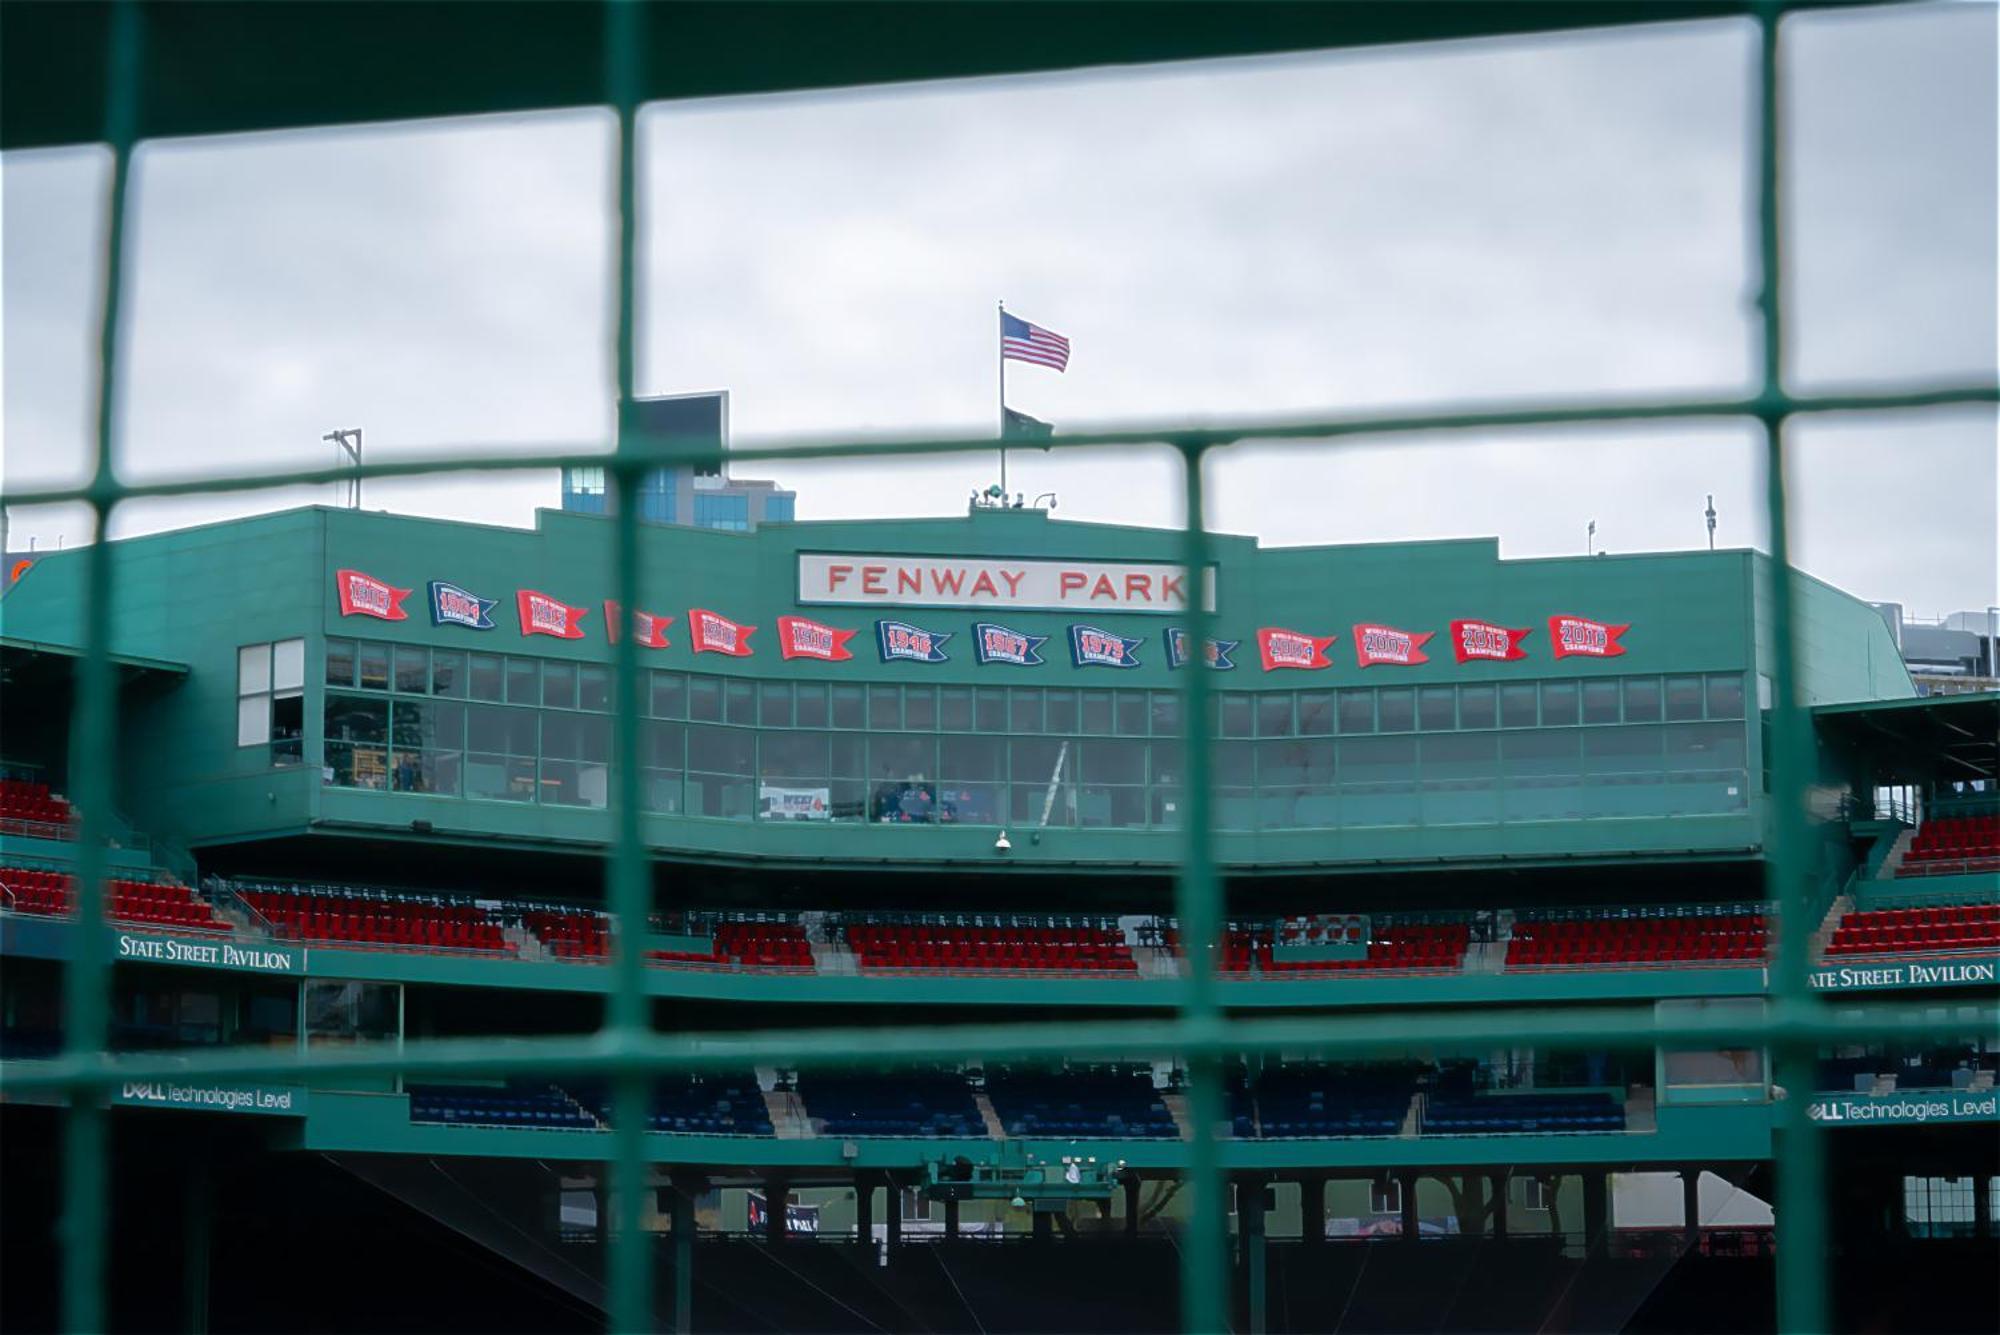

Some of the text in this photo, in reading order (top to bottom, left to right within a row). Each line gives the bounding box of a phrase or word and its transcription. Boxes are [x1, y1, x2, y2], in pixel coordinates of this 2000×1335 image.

[828, 565, 1187, 604] FENWAY PARK
[1363, 634, 1411, 654] 2007
[1462, 630, 1509, 652] 2013
[119, 935, 291, 971] STATE STREET PAVILION
[1807, 963, 1995, 988] ATE STREET PAVILION
[122, 1082, 292, 1109] DELL Technologies Level
[1806, 1097, 1997, 1121] ELL Technologies Level
